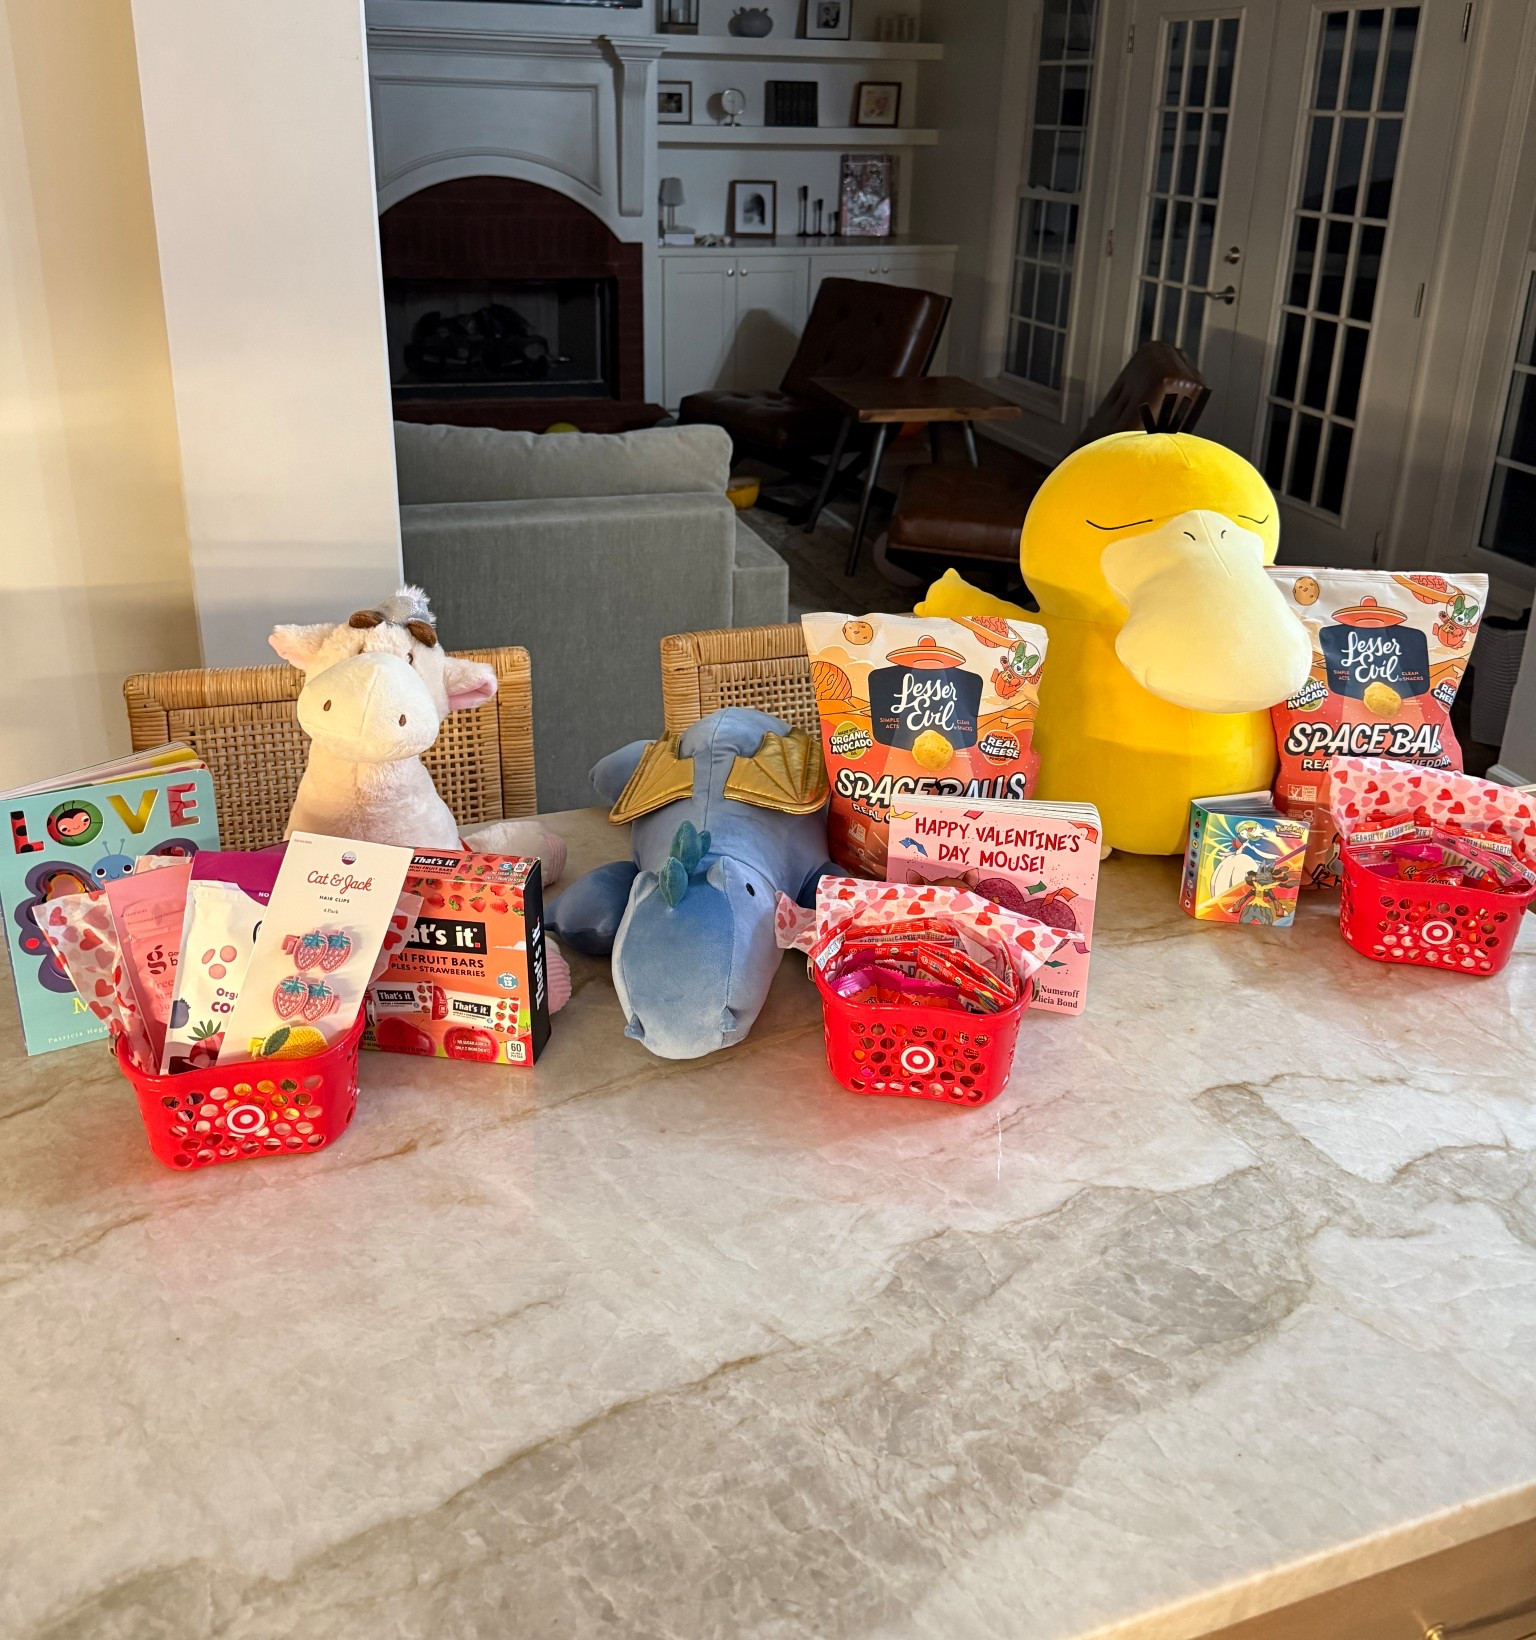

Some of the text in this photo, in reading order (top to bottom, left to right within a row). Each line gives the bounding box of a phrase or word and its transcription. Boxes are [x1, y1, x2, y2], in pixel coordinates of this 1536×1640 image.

[1341, 631, 1402, 666] Lesser
[1355, 651, 1399, 682] Evil
[891, 673, 958, 713] Lesser
[1441, 684, 1456, 696] REA
[1288, 689, 1328, 708] AVOCADO
[906, 696, 956, 731] Evil
[831, 730, 869, 745] ORGANIC
[988, 736, 1017, 748] REAL
[1288, 722, 1388, 754] SPACE
[832, 739, 873, 753] AVOCADO
[980, 742, 1019, 758] CHEESE
[1303, 760, 1332, 770] REA
[10, 782, 200, 854] LOVE
[853, 803, 882, 821] REAL
[915, 817, 1081, 853] HAPPY VALENTINE'S
[414, 856, 444, 865] That's
[938, 844, 1045, 874] DAY, MOUSE!
[308, 870, 372, 894] Cat & Jack
[408, 924, 447, 946] at's
[411, 954, 448, 965] FRUIT
[451, 957, 484, 968] BARS
[419, 965, 486, 977] STRAWBERRIES
[534, 944, 544, 1011] That's
[1040, 985, 1080, 998] Numeroff
[454, 1002, 478, 1012] That's
[1036, 995, 1078, 1008] licia Bond
[48, 1032, 83, 1043] Patricia
[510, 1043, 522, 1052] 60
